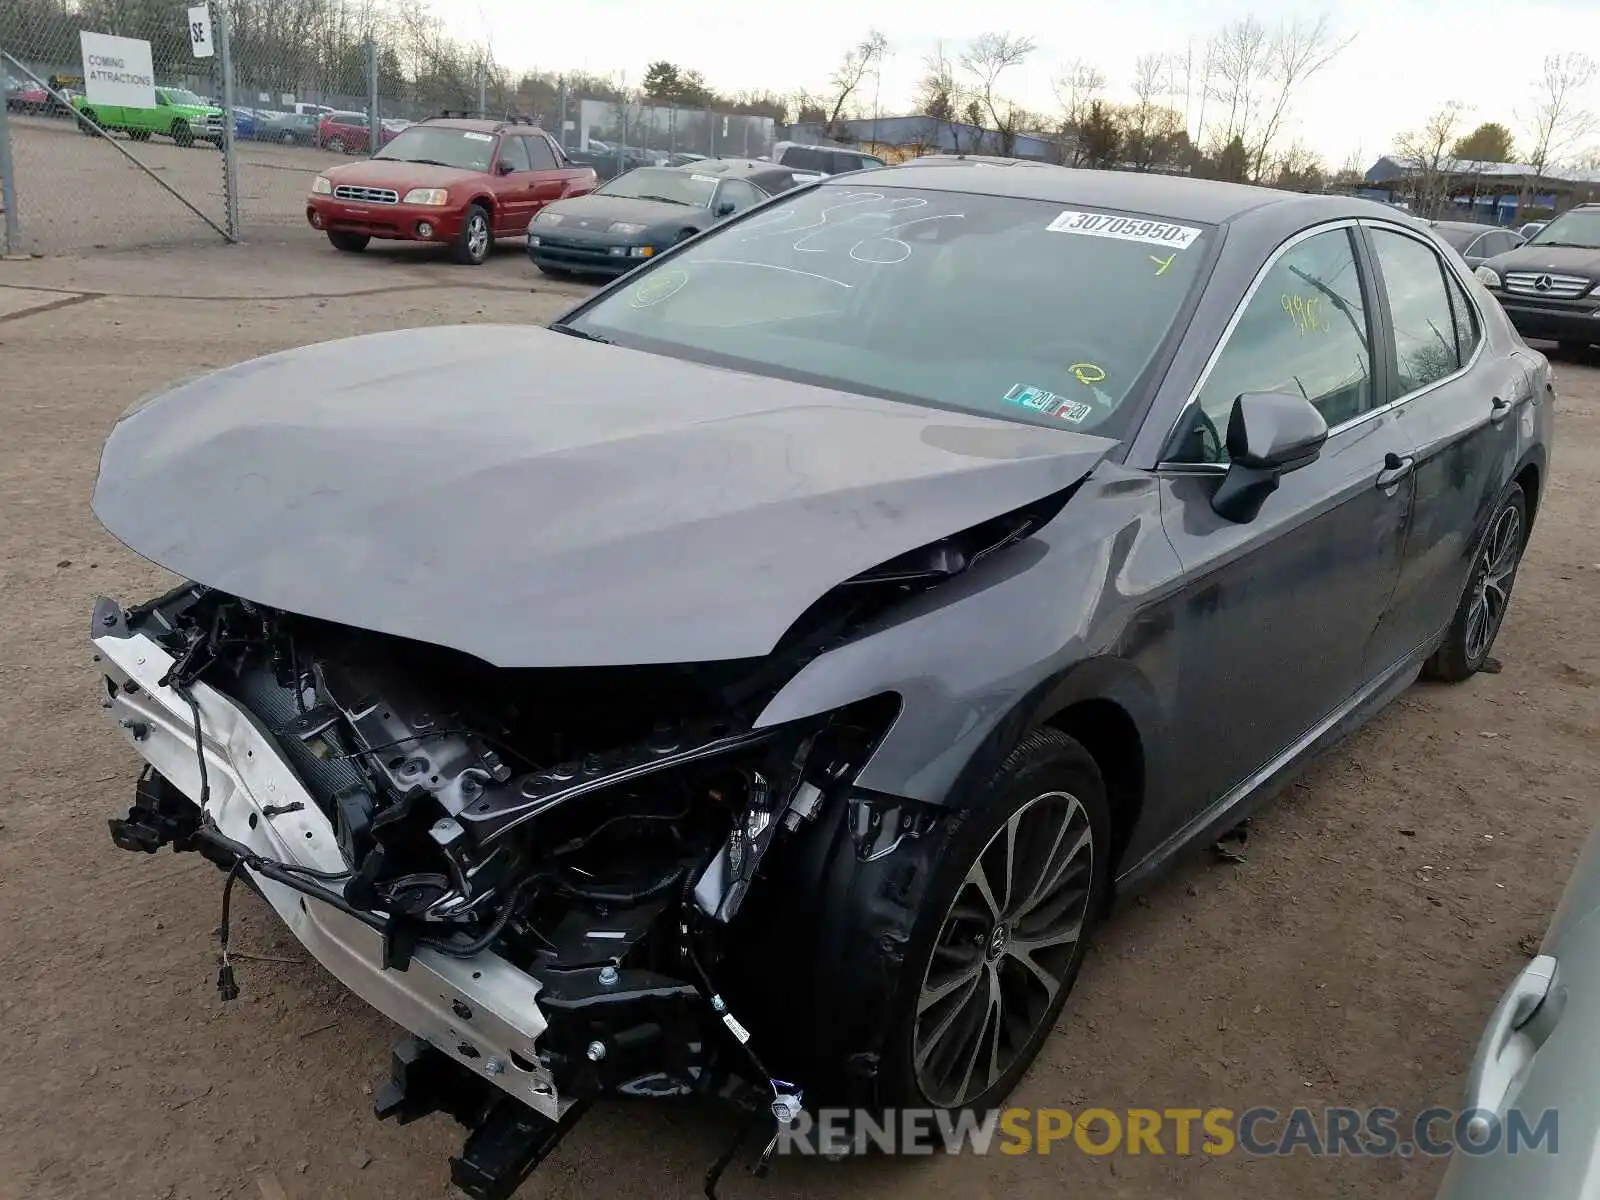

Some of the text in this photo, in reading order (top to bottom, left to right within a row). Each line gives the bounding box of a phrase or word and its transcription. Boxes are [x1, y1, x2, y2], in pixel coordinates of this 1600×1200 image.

[192, 22, 205, 43] SE
[88, 54, 126, 69] COMING
[90, 70, 152, 87] ATTRACTIONS
